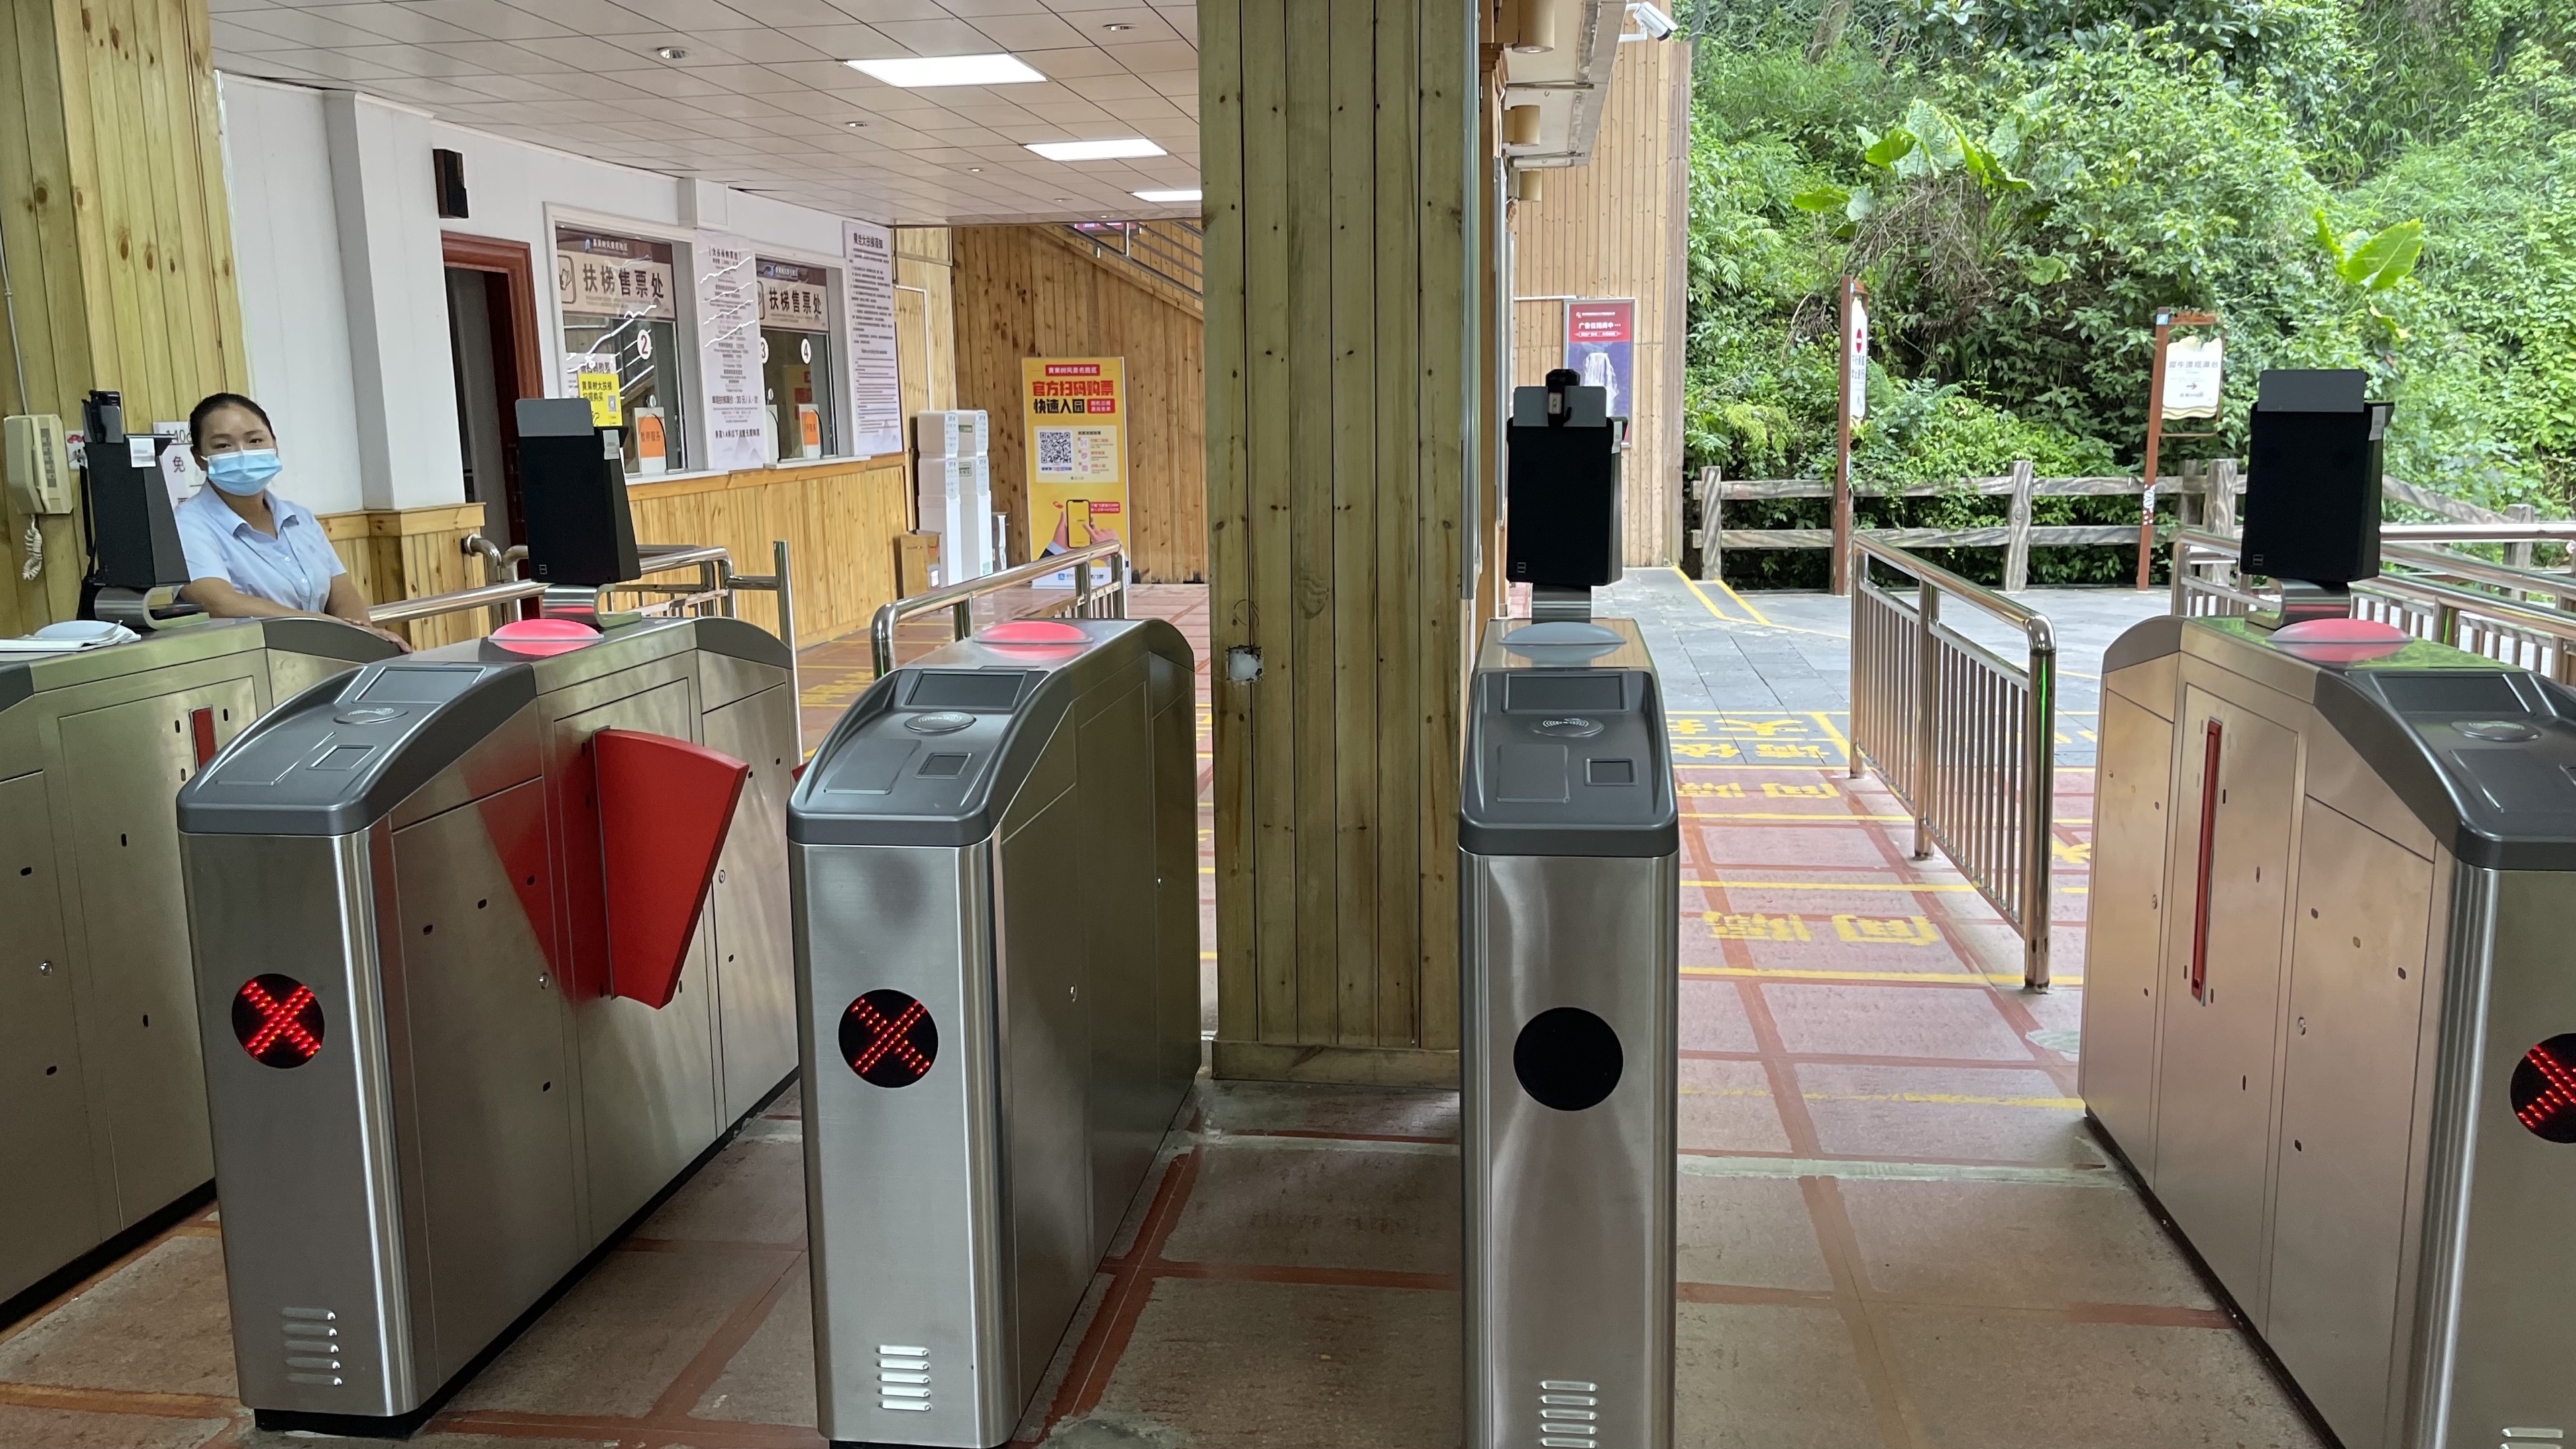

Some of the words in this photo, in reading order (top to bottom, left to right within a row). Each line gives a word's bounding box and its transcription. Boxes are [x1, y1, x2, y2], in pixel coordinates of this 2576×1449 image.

[583, 264, 664, 299] 扶梯售票处
[769, 287, 822, 315] 扶梯售票处
[641, 334, 648, 355] 2
[760, 342, 765, 358] 3
[804, 343, 809, 360] 4
[582, 381, 612, 392] 黄果树大扶梯
[1032, 380, 1114, 396] 官方扫码购票
[1033, 398, 1085, 414] 快速入园
